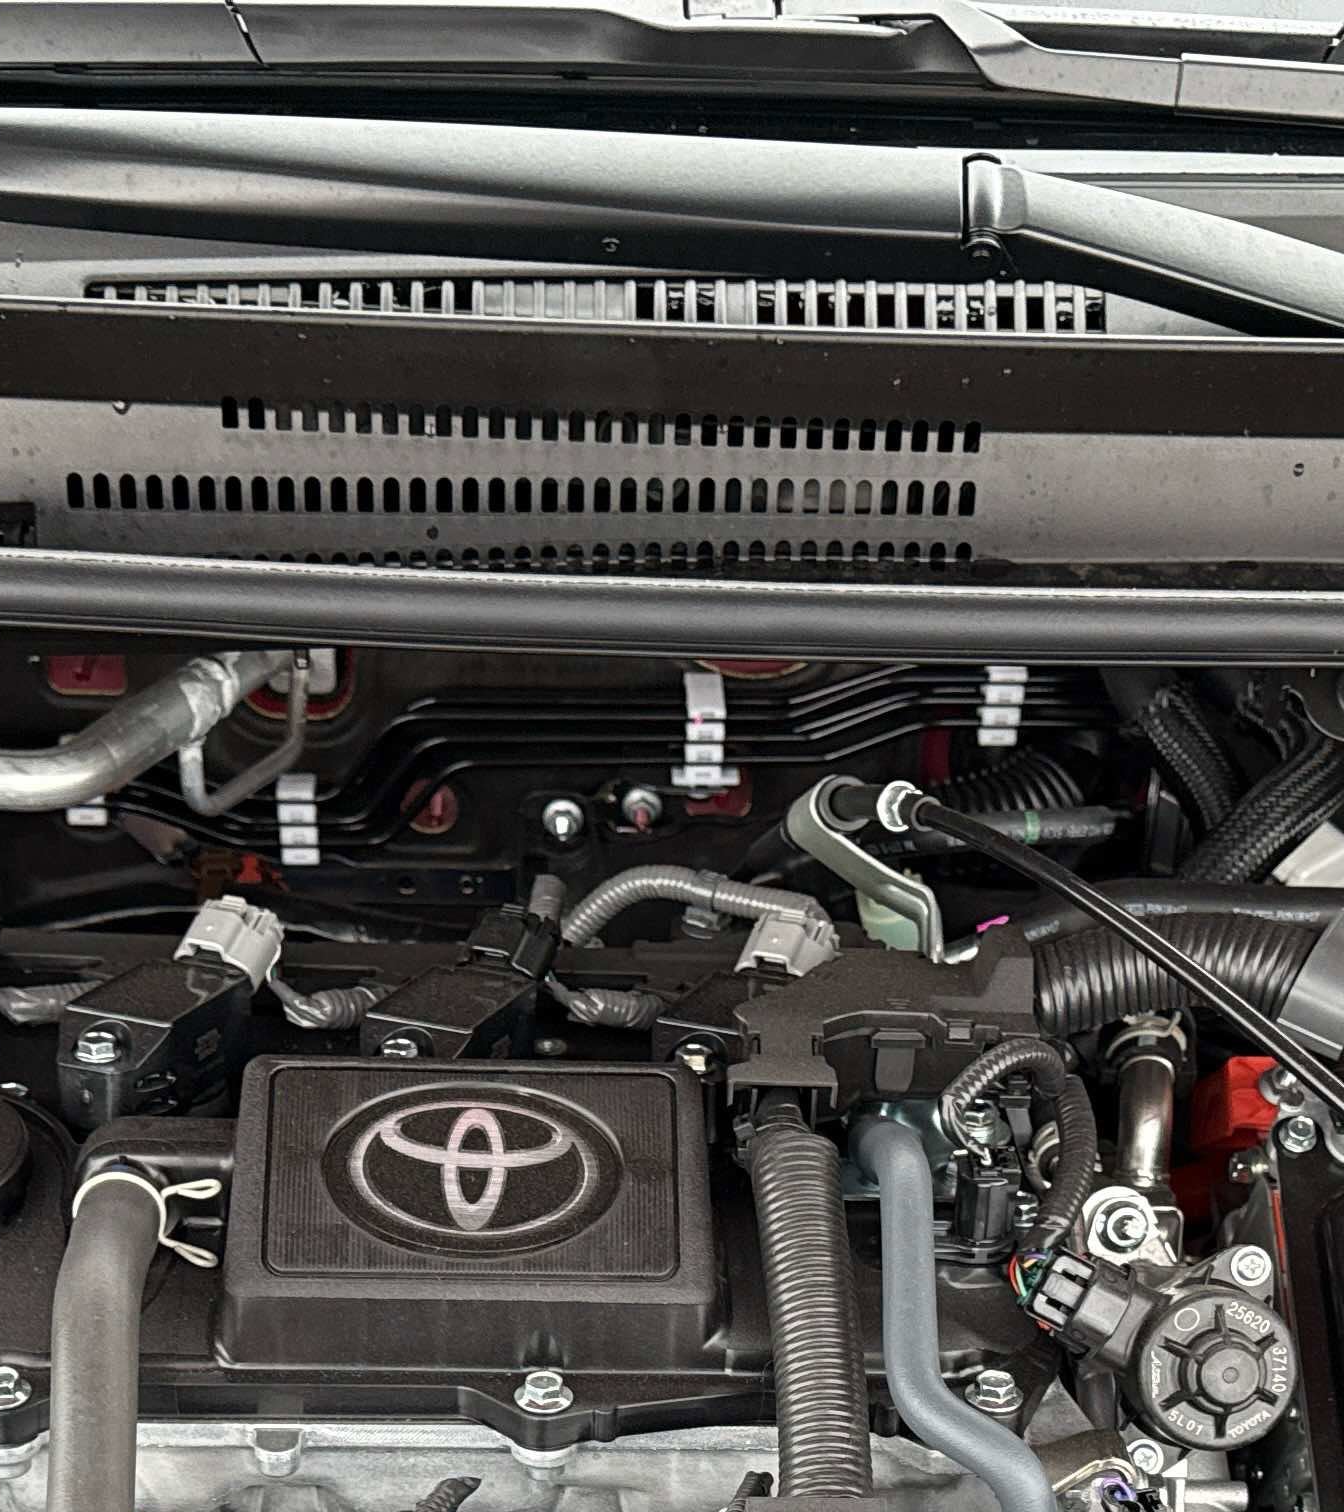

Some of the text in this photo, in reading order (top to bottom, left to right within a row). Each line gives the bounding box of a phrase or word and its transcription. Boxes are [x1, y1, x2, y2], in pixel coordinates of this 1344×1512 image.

[1224, 1301, 1271, 1333] 25620
[1271, 1346, 1288, 1393] 37140
[1167, 1410, 1204, 1436] 5L01
[1229, 1409, 1272, 1439] TOYOTA
